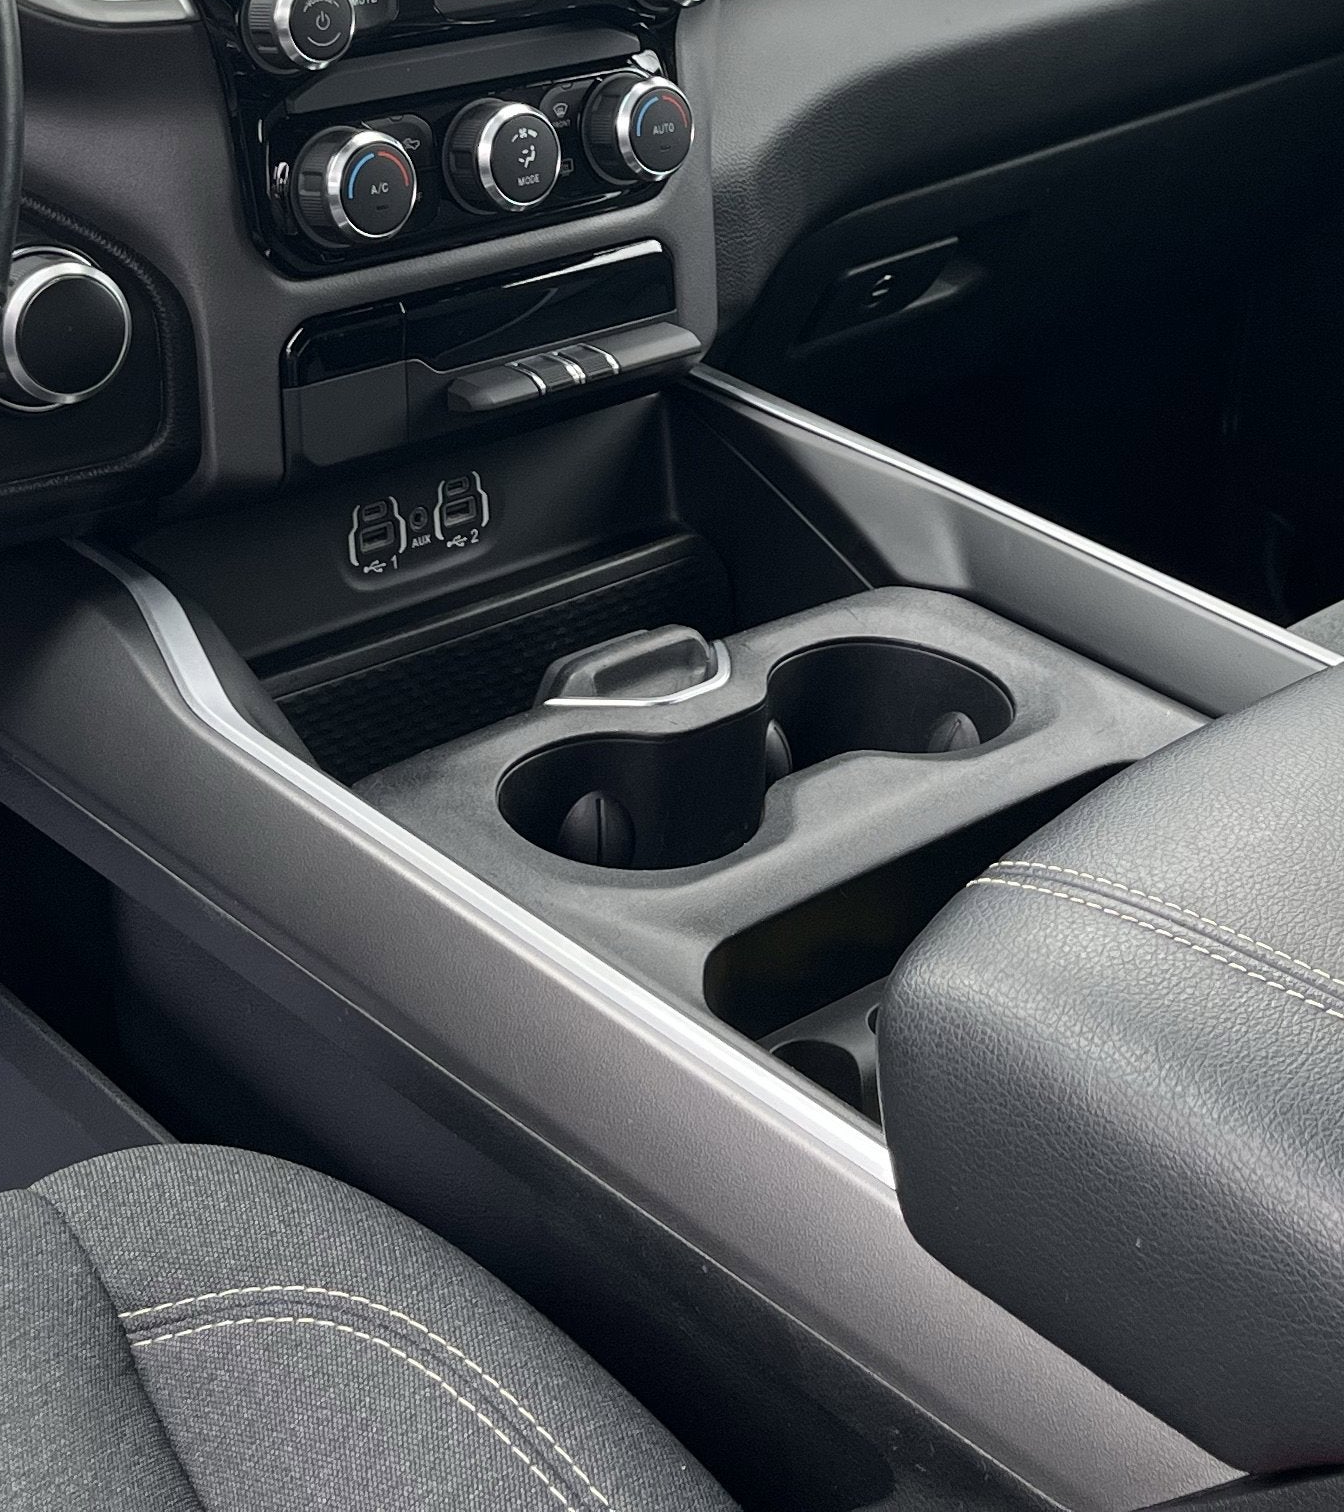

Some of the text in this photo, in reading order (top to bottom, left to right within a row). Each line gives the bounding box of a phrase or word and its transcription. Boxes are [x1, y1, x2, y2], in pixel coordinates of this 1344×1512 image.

[653, 123, 675, 136] AUTO
[517, 174, 540, 187] MODE
[370, 181, 389, 195] A/C
[411, 534, 432, 548] AUX
[470, 528, 480, 544] 2
[390, 554, 398, 569] 1
